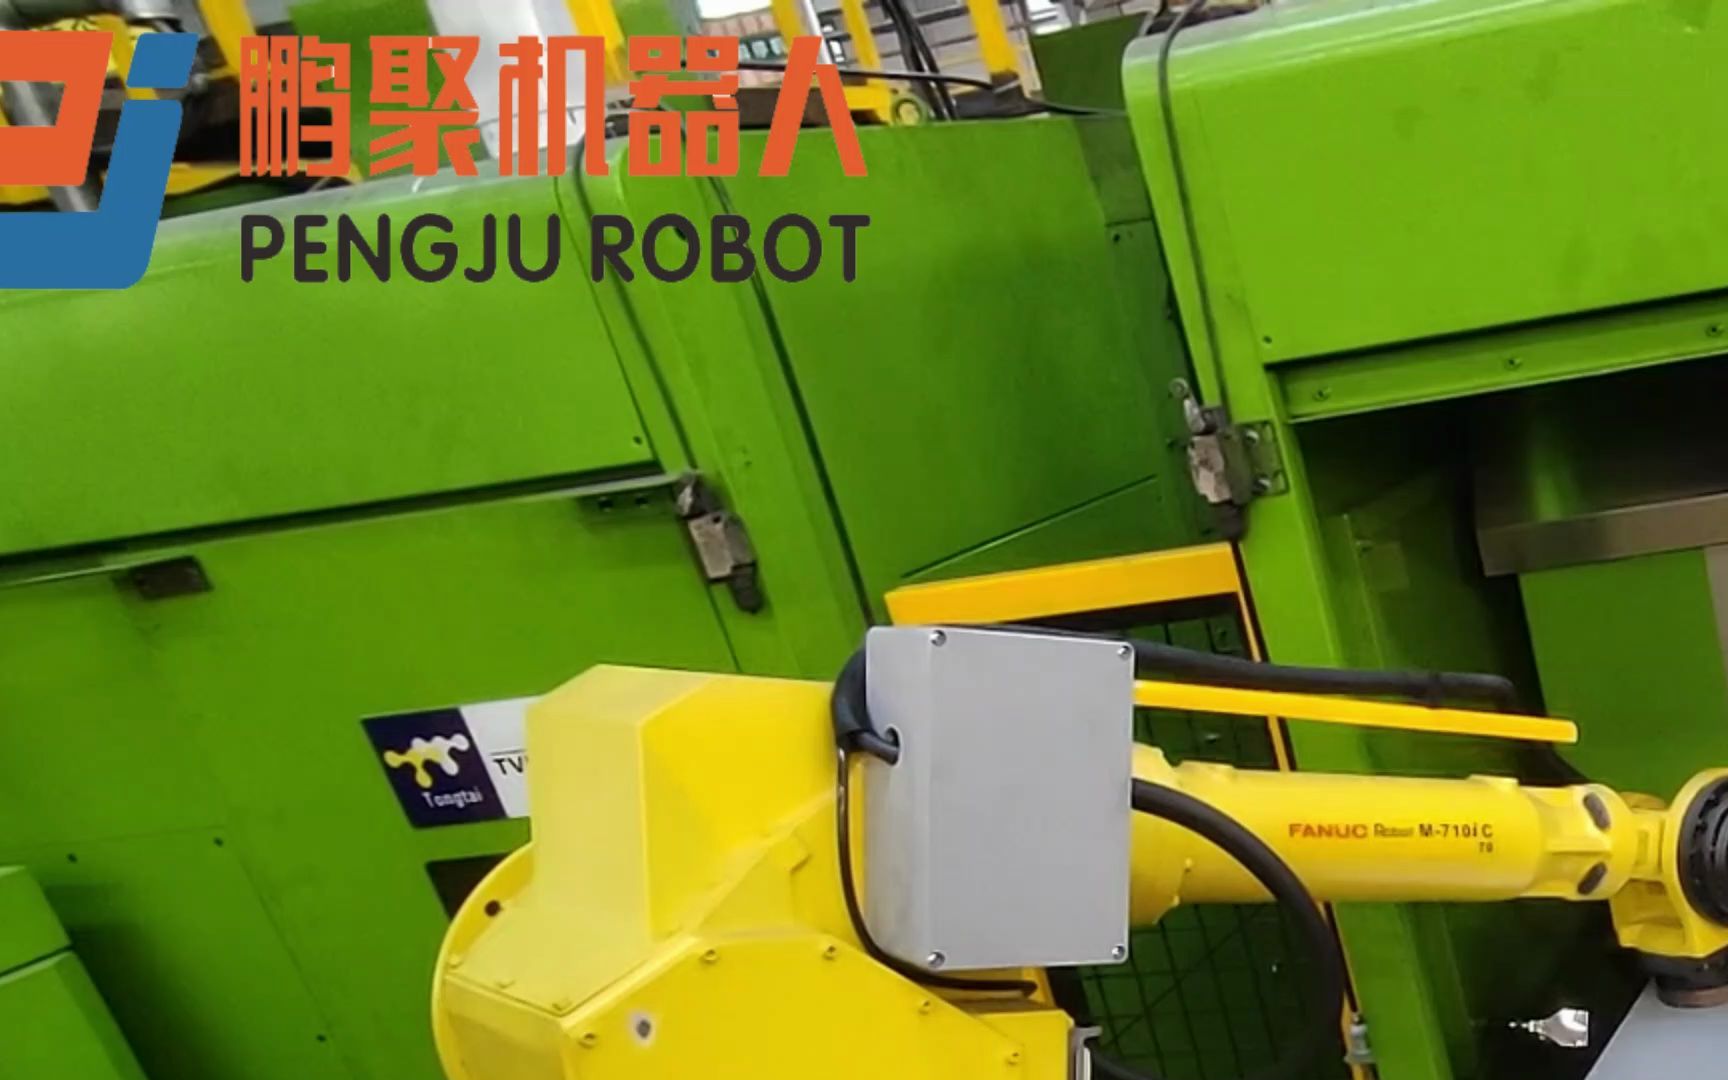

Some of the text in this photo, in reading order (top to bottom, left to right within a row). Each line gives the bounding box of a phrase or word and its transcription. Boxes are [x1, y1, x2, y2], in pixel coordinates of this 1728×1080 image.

[492, 755, 529, 775] TV
[422, 786, 483, 809] Tongtai
[1289, 823, 1368, 839] FANUC
